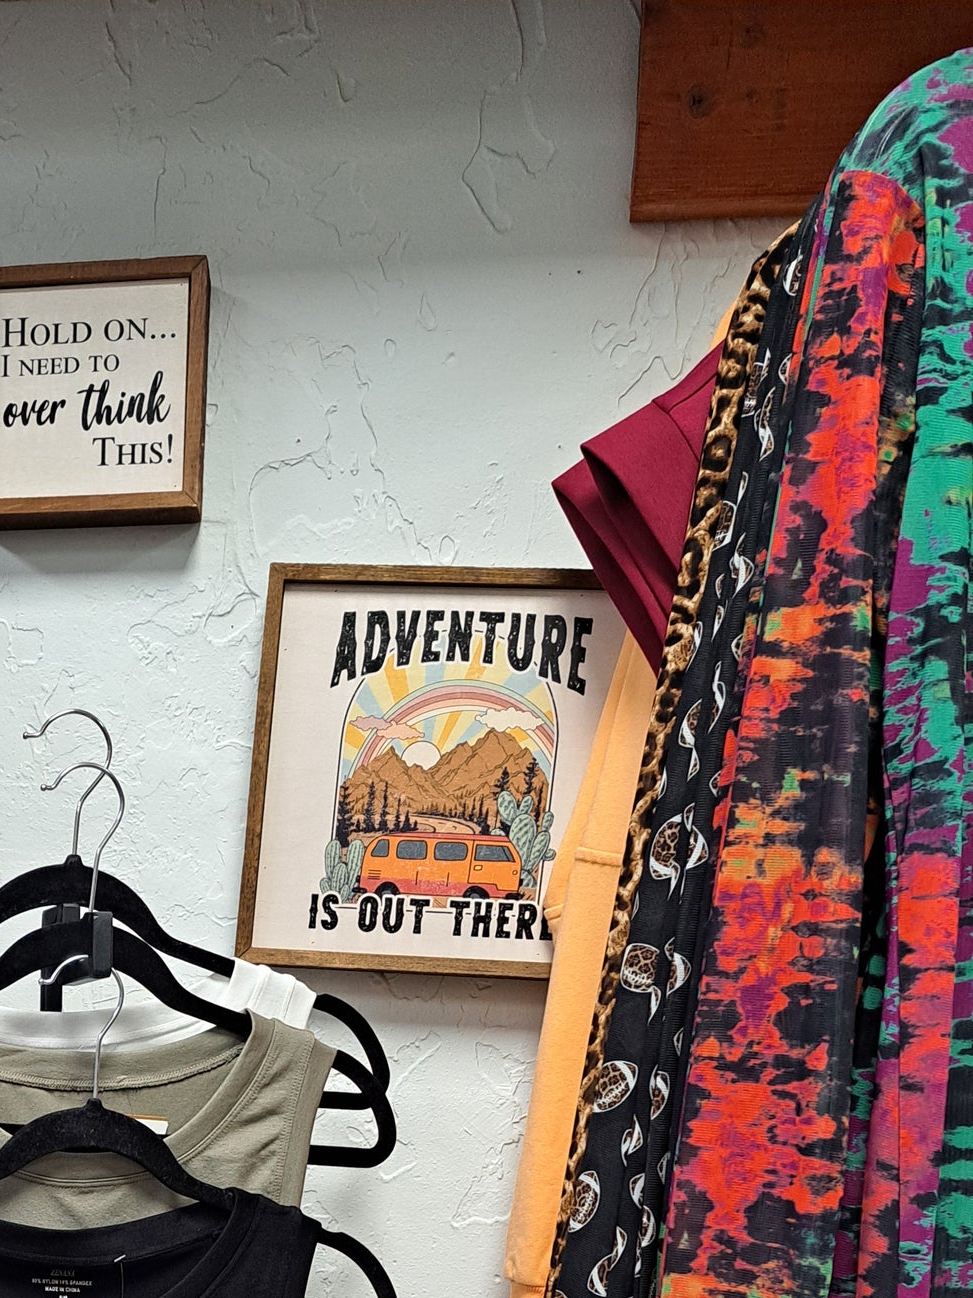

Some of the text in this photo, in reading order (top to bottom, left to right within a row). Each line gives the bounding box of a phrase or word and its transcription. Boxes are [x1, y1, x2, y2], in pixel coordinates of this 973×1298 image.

[1, 354, 120, 377] I NEED TO
[2, 370, 171, 431] over think
[330, 610, 594, 695] ADVENTURE
[308, 894, 339, 930] IS
[357, 896, 430, 934] OUT
